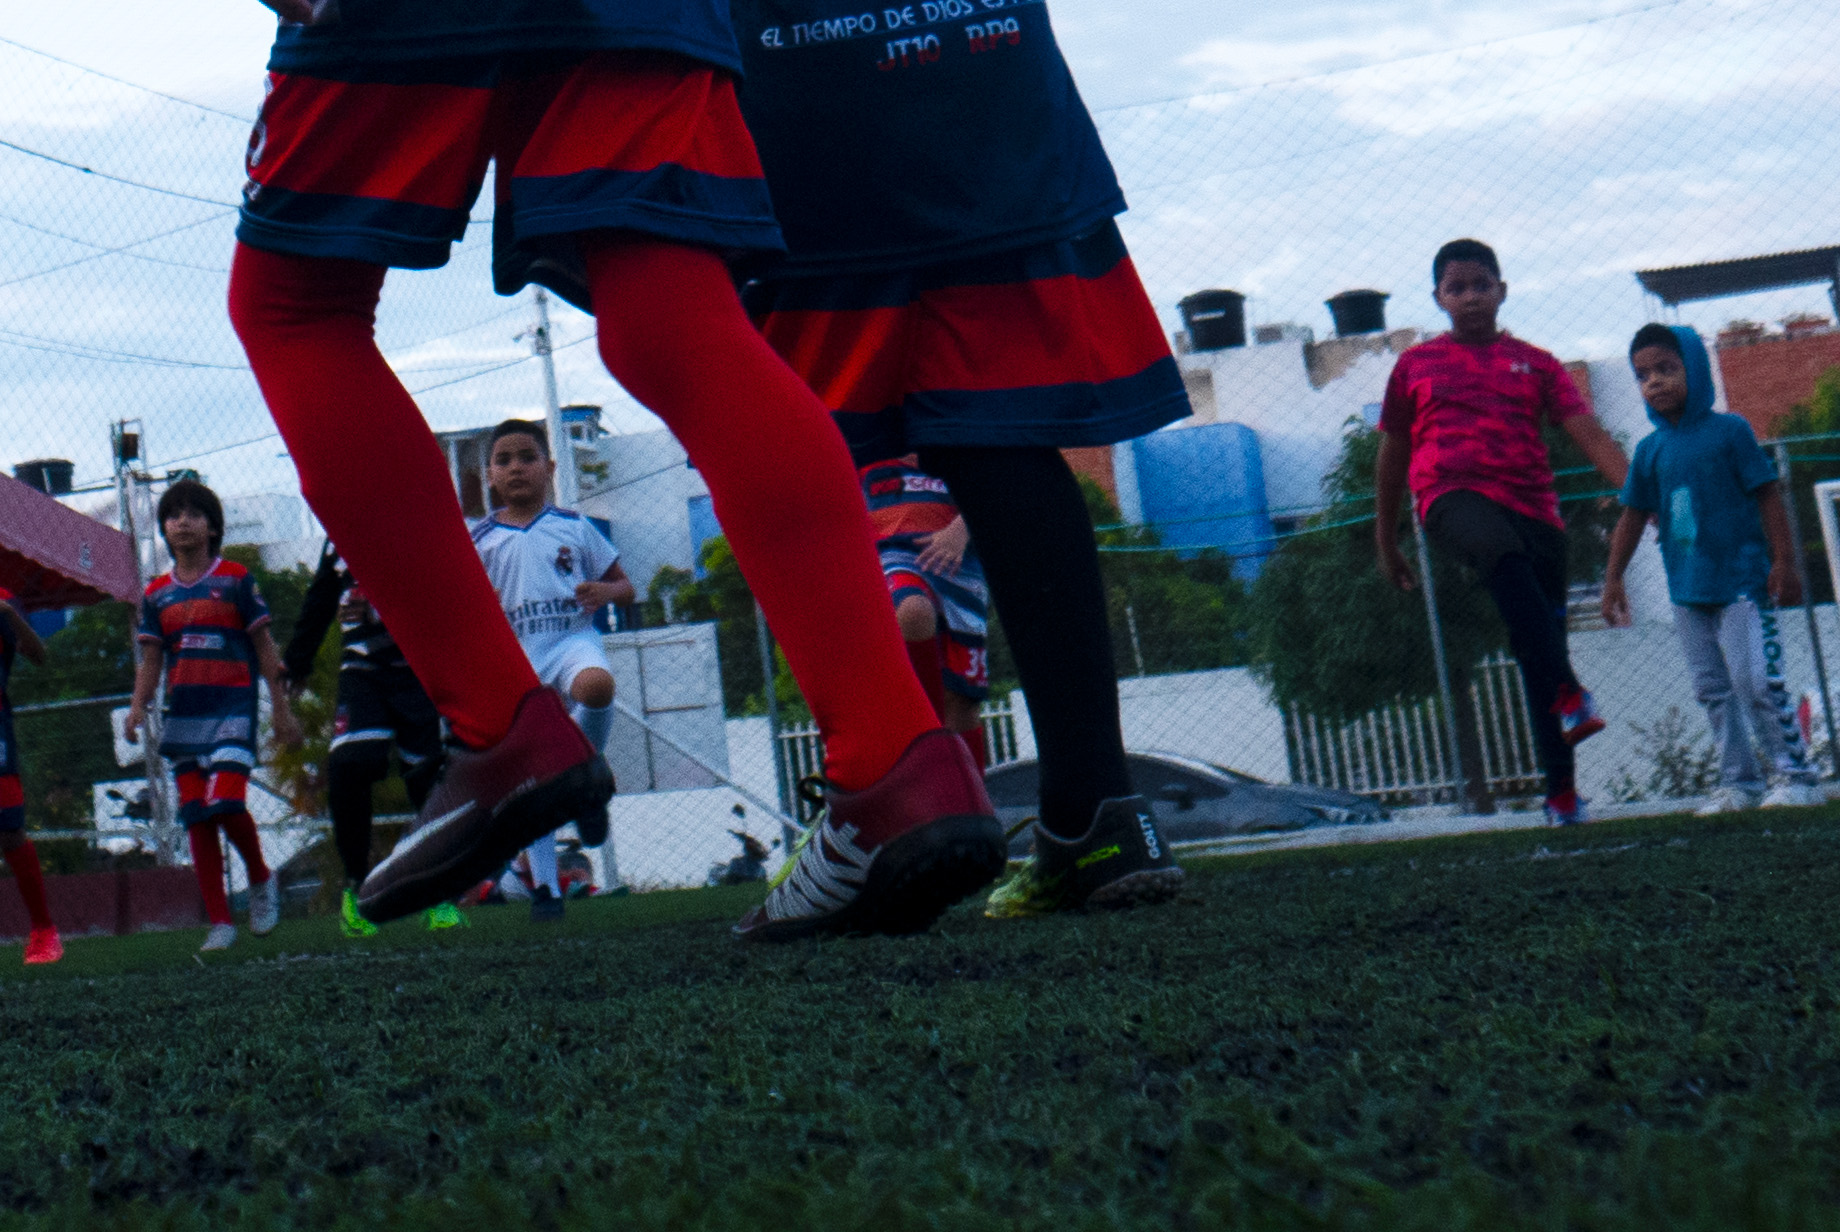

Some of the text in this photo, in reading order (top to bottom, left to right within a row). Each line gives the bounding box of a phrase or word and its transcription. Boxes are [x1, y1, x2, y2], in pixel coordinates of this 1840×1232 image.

[760, 26, 784, 48] EL
[792, 12, 876, 46] TIEMPO
[883, 4, 917, 30] DE
[876, 33, 941, 72] JT10
